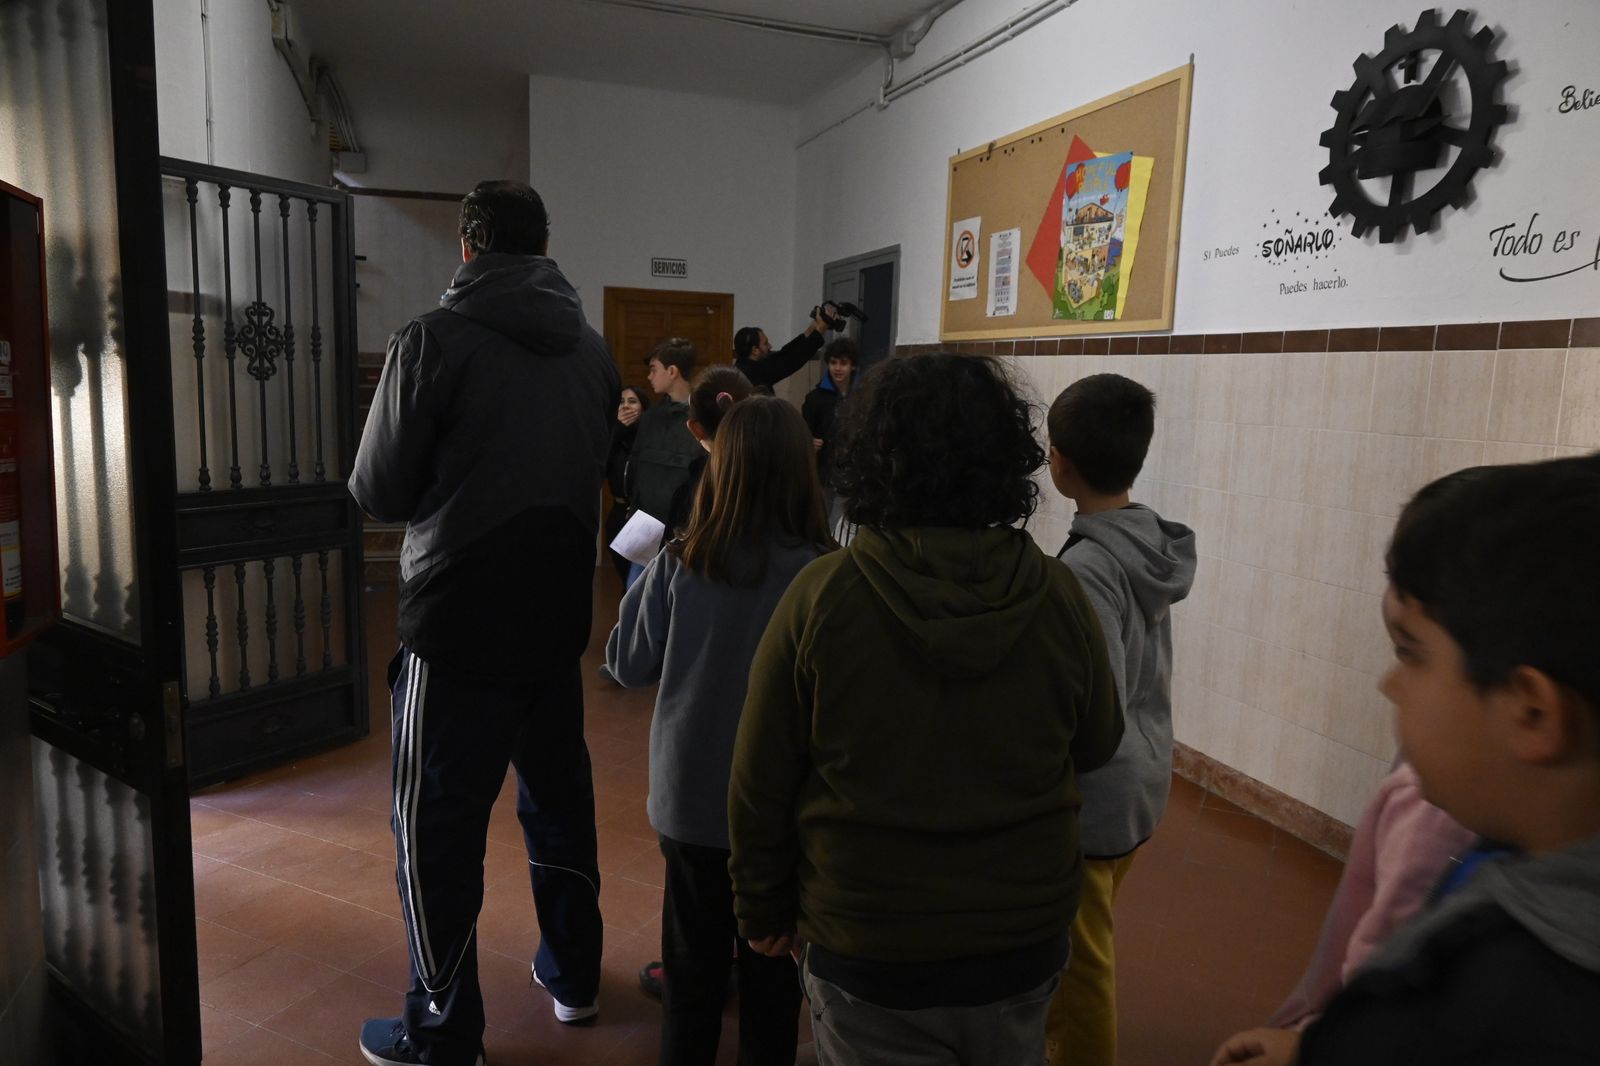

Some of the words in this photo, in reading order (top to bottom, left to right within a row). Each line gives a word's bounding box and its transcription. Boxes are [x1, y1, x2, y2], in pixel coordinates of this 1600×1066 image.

[1490, 213, 1543, 256] Todo
[1553, 231, 1580, 254] es
[1214, 245, 1240, 259] Puedes
[653, 261, 686, 275] SERVICIOS
[1279, 280, 1308, 295] Puedes
[1313, 275, 1349, 290] hacerlo.
